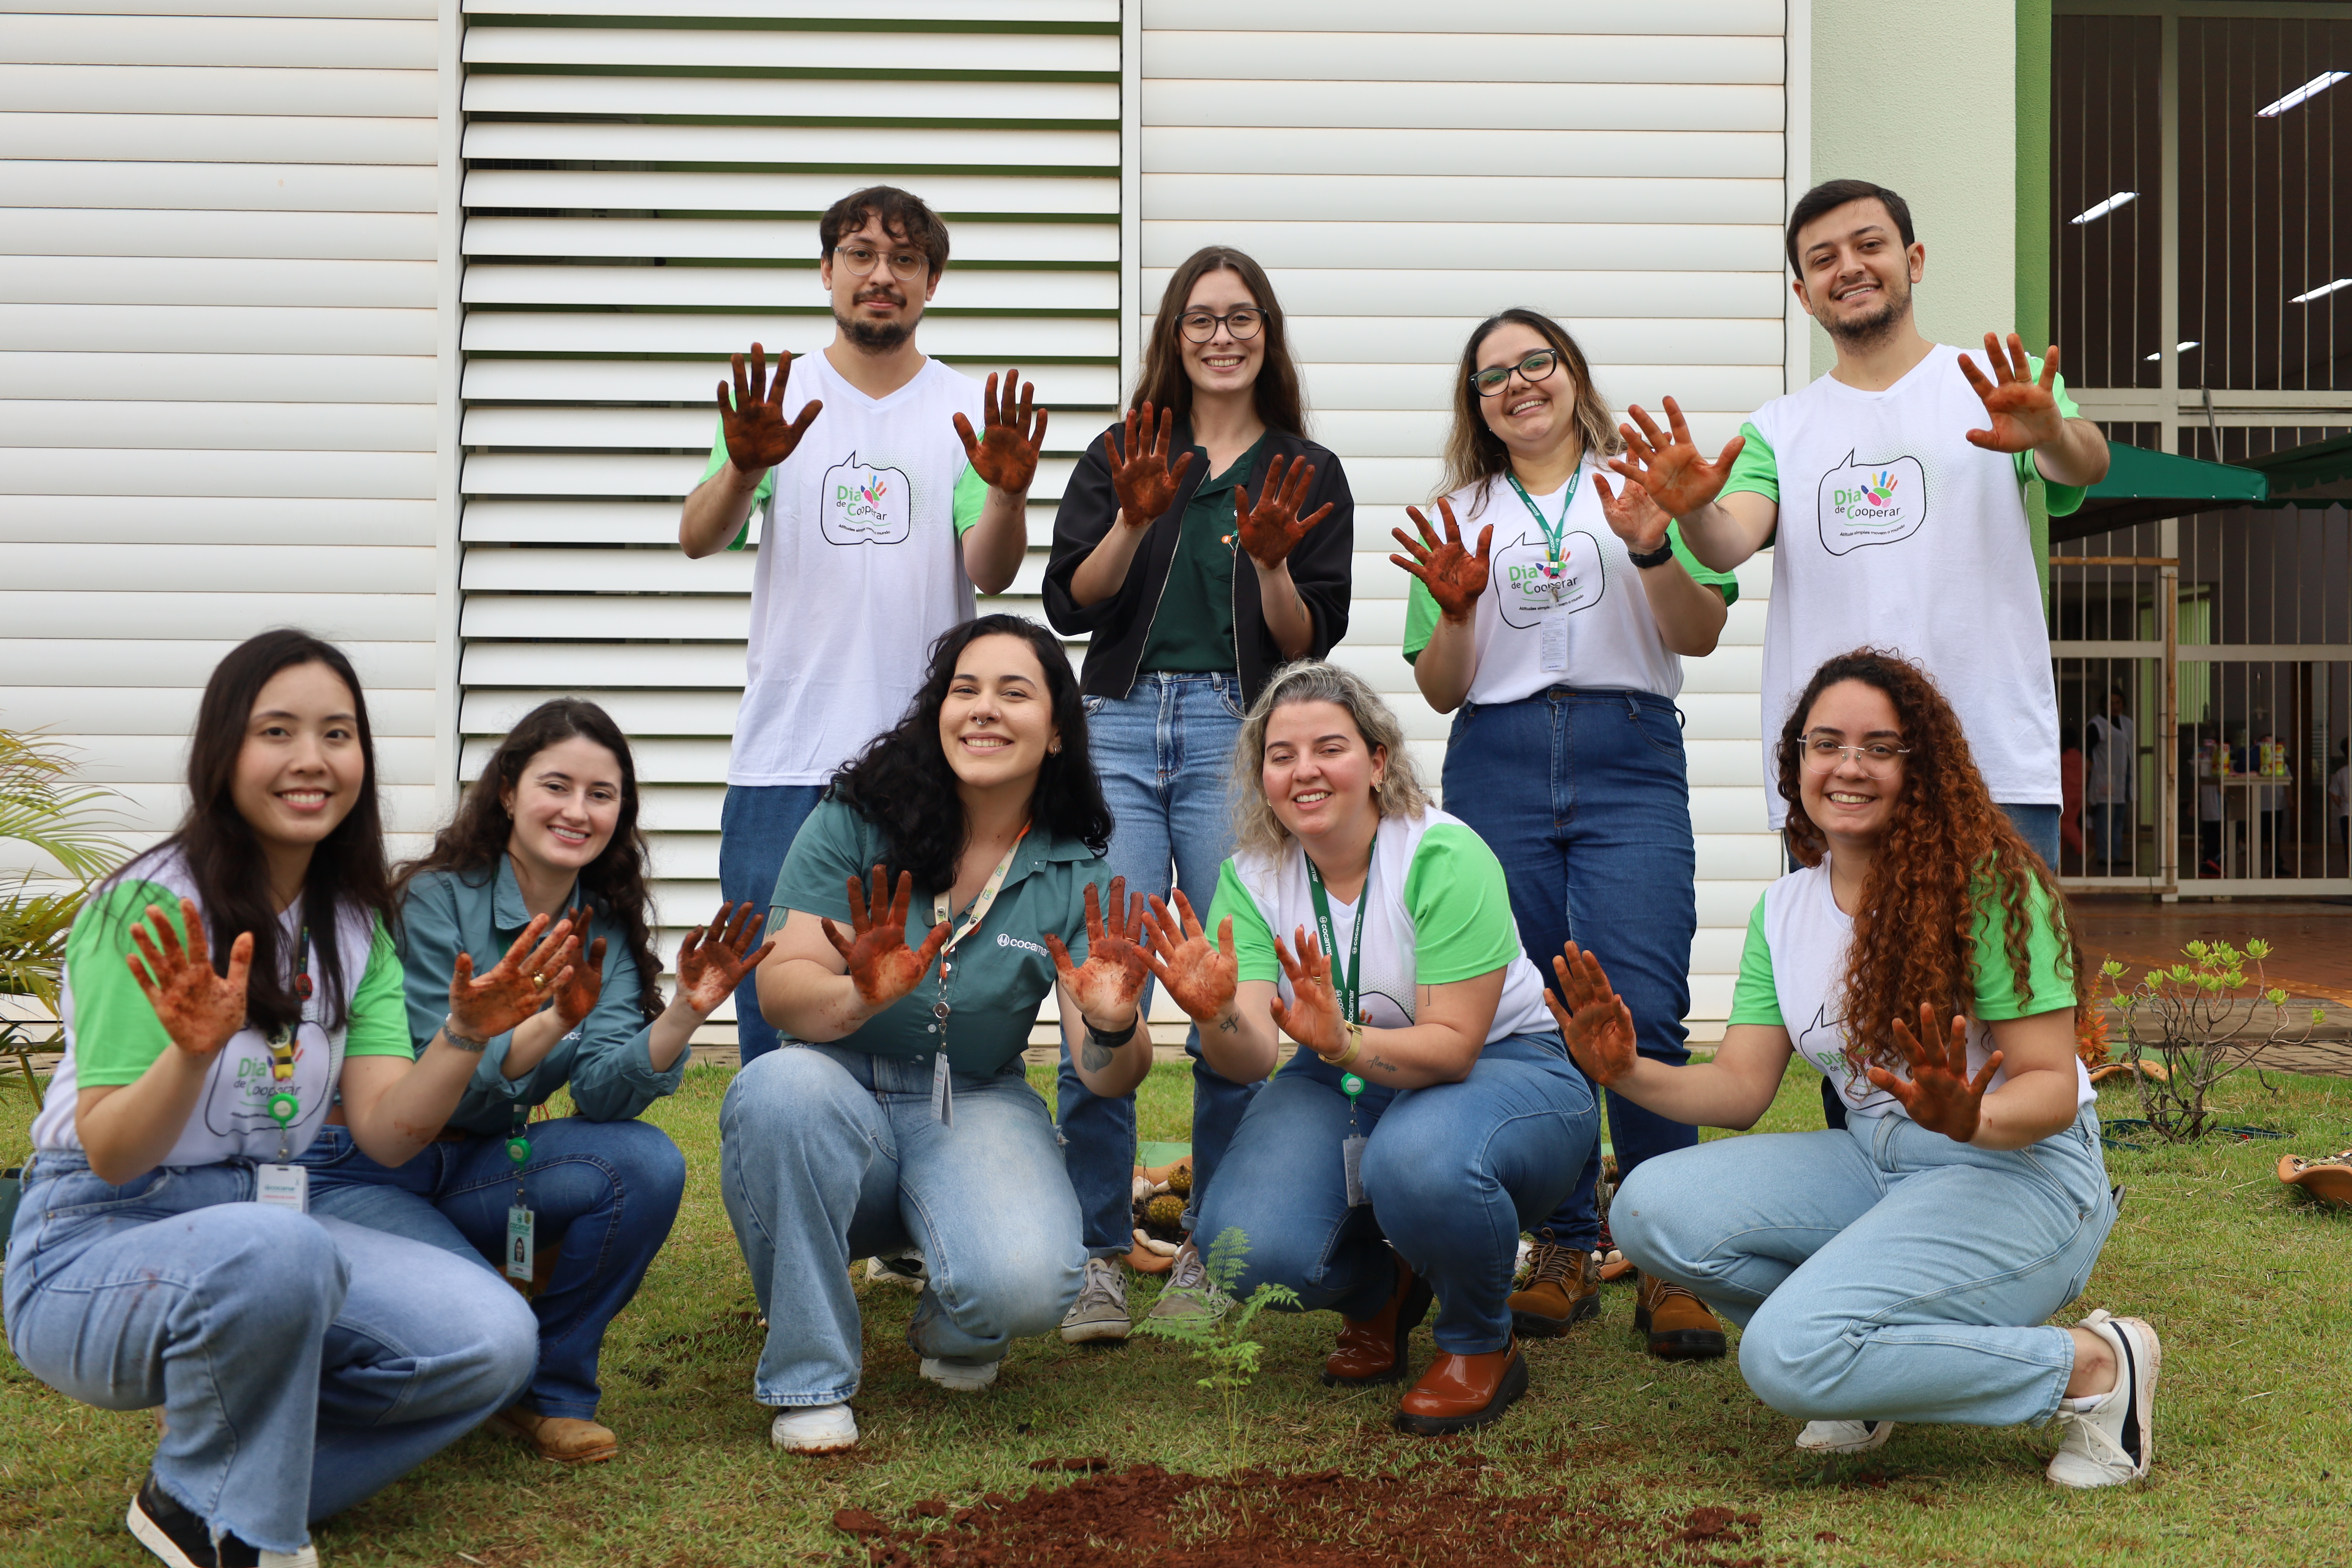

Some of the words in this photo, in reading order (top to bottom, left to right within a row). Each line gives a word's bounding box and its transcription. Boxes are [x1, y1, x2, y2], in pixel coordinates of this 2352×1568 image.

[837, 485, 861, 502] Dia
[1834, 488, 1862, 506] Dia
[847, 503, 887, 521] Cooperar
[1834, 505, 1845, 514] de
[1847, 505, 1901, 519] Cooperar
[1891, 524, 1905, 533] mundo
[1508, 565, 1538, 581] Dia
[1571, 594, 1584, 603] mundo
[1010, 939, 1050, 957] cocamar
[1816, 1050, 1847, 1066] Dia
[237, 1057, 266, 1078] Dia
[234, 1080, 246, 1088] de
[510, 1222, 530, 1232] cocamar
